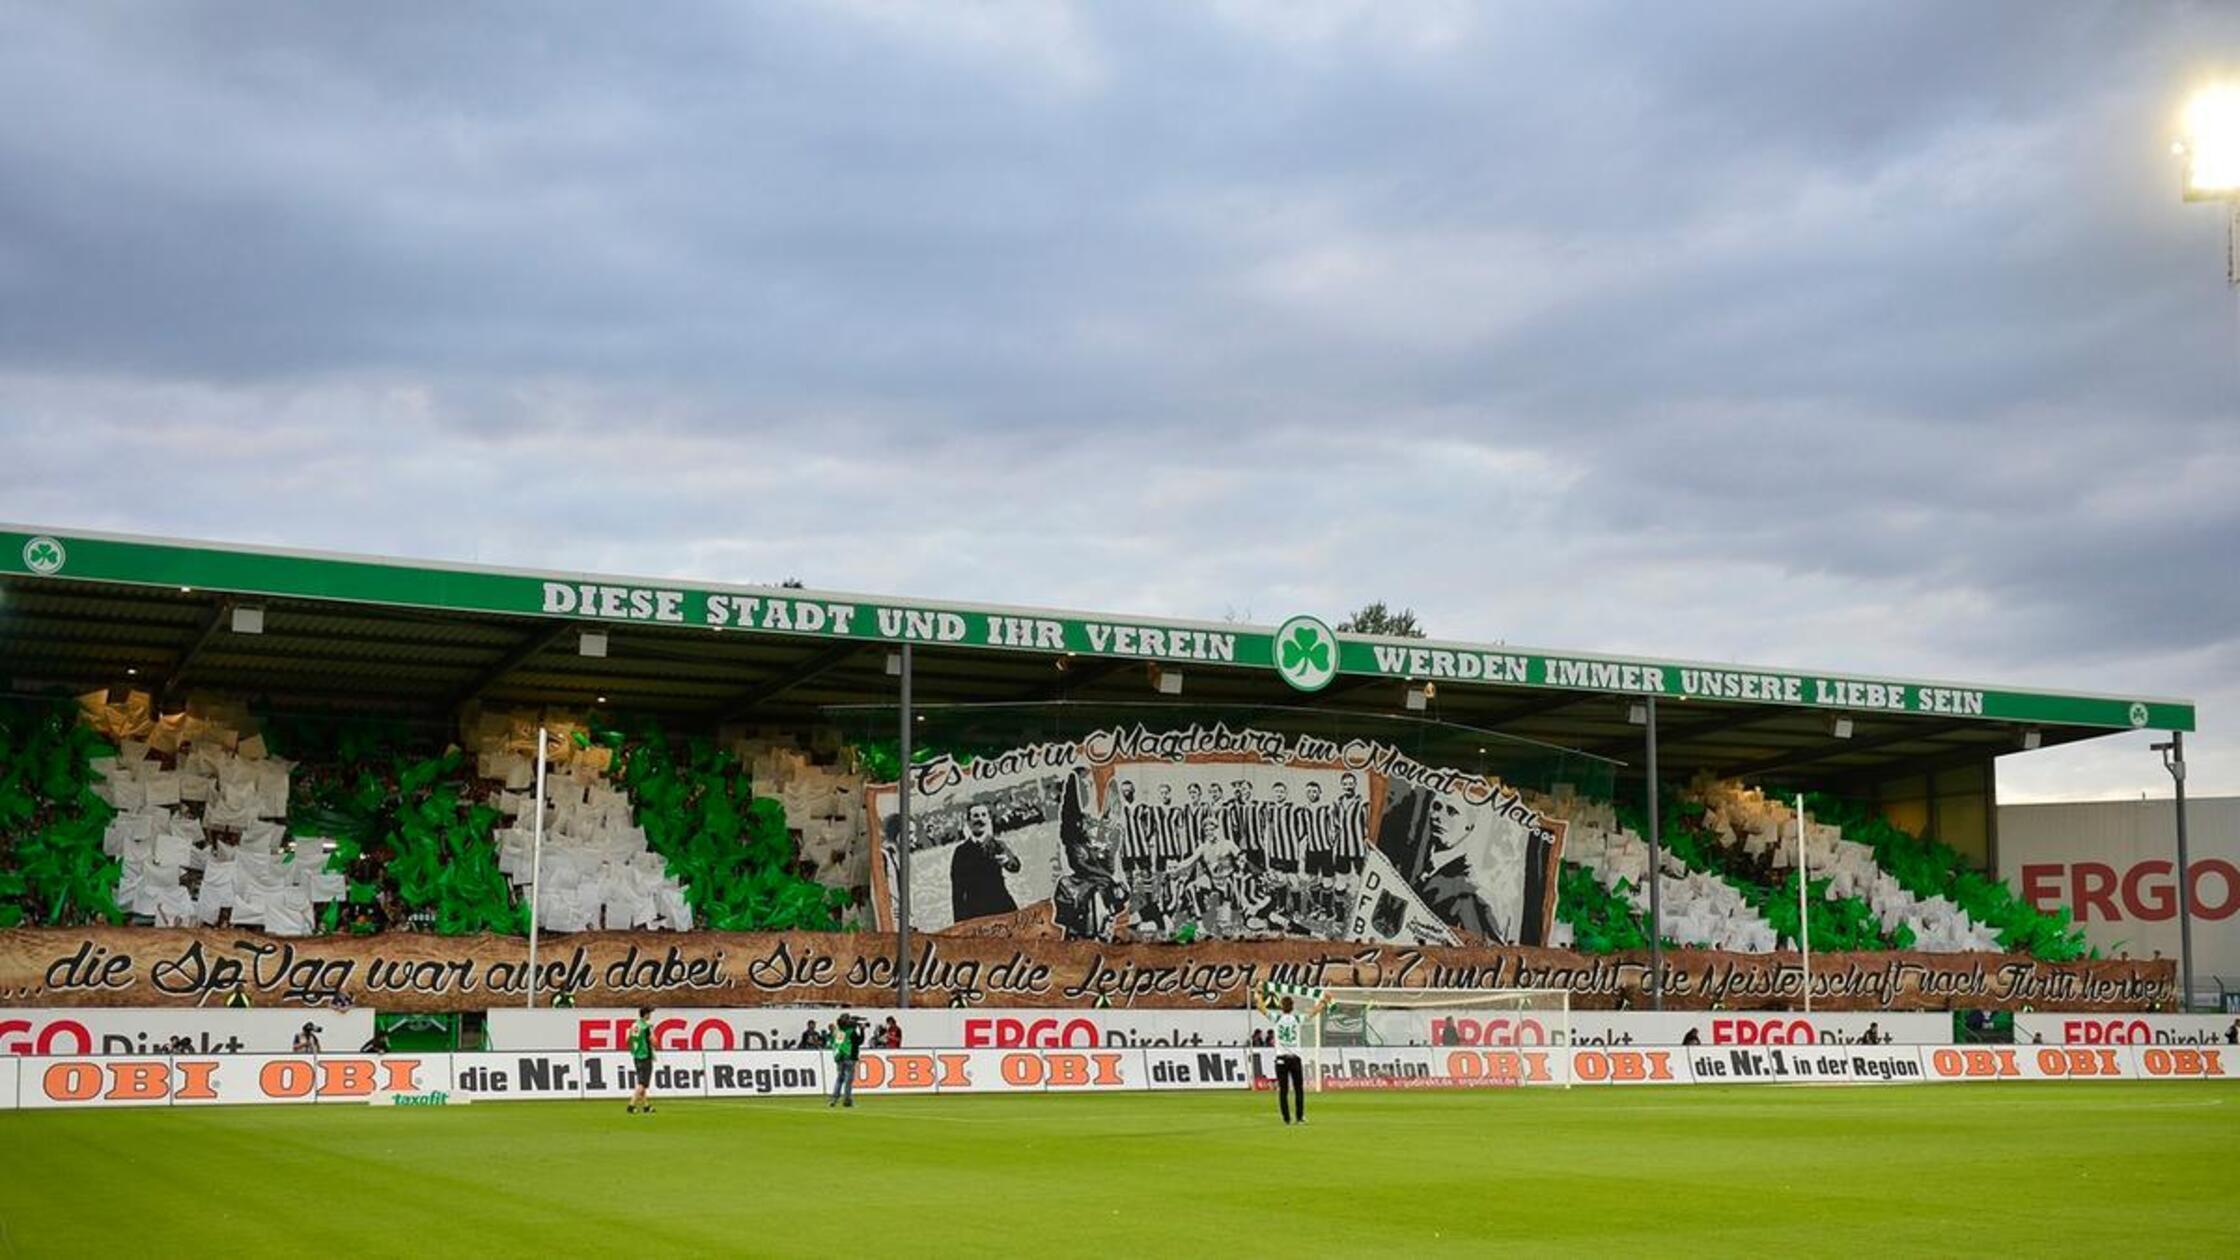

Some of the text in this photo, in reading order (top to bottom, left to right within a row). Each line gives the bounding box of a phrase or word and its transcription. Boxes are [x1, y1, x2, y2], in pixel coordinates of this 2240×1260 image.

[543, 582, 1984, 716] DIESE STADT UND IHR VEREIN WERDEN IMMER UNSERE LIEBE SEIN
[911, 756, 962, 796] Es
[971, 747, 1037, 780] war
[1043, 743, 1076, 767] in
[1298, 735, 1335, 761] im
[1344, 741, 1460, 796] Monat
[2022, 859, 2240, 922] ERGO
[366, 956, 478, 993] war
[485, 946, 598, 994] auch
[750, 940, 838, 991] Sie
[847, 940, 986, 1001] schlug
[987, 951, 1053, 994] die
[1065, 954, 1257, 1005] Leipziger
[1433, 956, 1505, 990] und
[1918, 960, 1988, 998] nach
[103, 1031, 244, 1054] Dirkt
[965, 1018, 1099, 1048] ERGO
[1713, 1020, 1892, 1044] ERGO Dirt
[2064, 1020, 2151, 1045] ERGO
[852, 1054, 970, 1088] OBI
[1000, 1052, 1124, 1086] OBI
[1153, 1060, 1190, 1083] die
[1350, 1057, 1430, 1079] Region
[1447, 1051, 1552, 1080] OBI
[1574, 1051, 1674, 1081] OBI
[1695, 1056, 1725, 1077] die
[1794, 1056, 1812, 1075] in
[1817, 1055, 1848, 1076] der
[1854, 1056, 1919, 1080] Region
[1933, 1048, 2020, 1076] OBI
[2038, 1048, 2121, 1076] OBI
[2143, 1048, 2226, 1076] OBI
[43, 1062, 220, 1100] OBI
[259, 1059, 421, 1096] OBI
[459, 1066, 508, 1092] die
[655, 1065, 704, 1090] der
[713, 1064, 817, 1093] Region
[391, 1090, 449, 1105] taxofit
